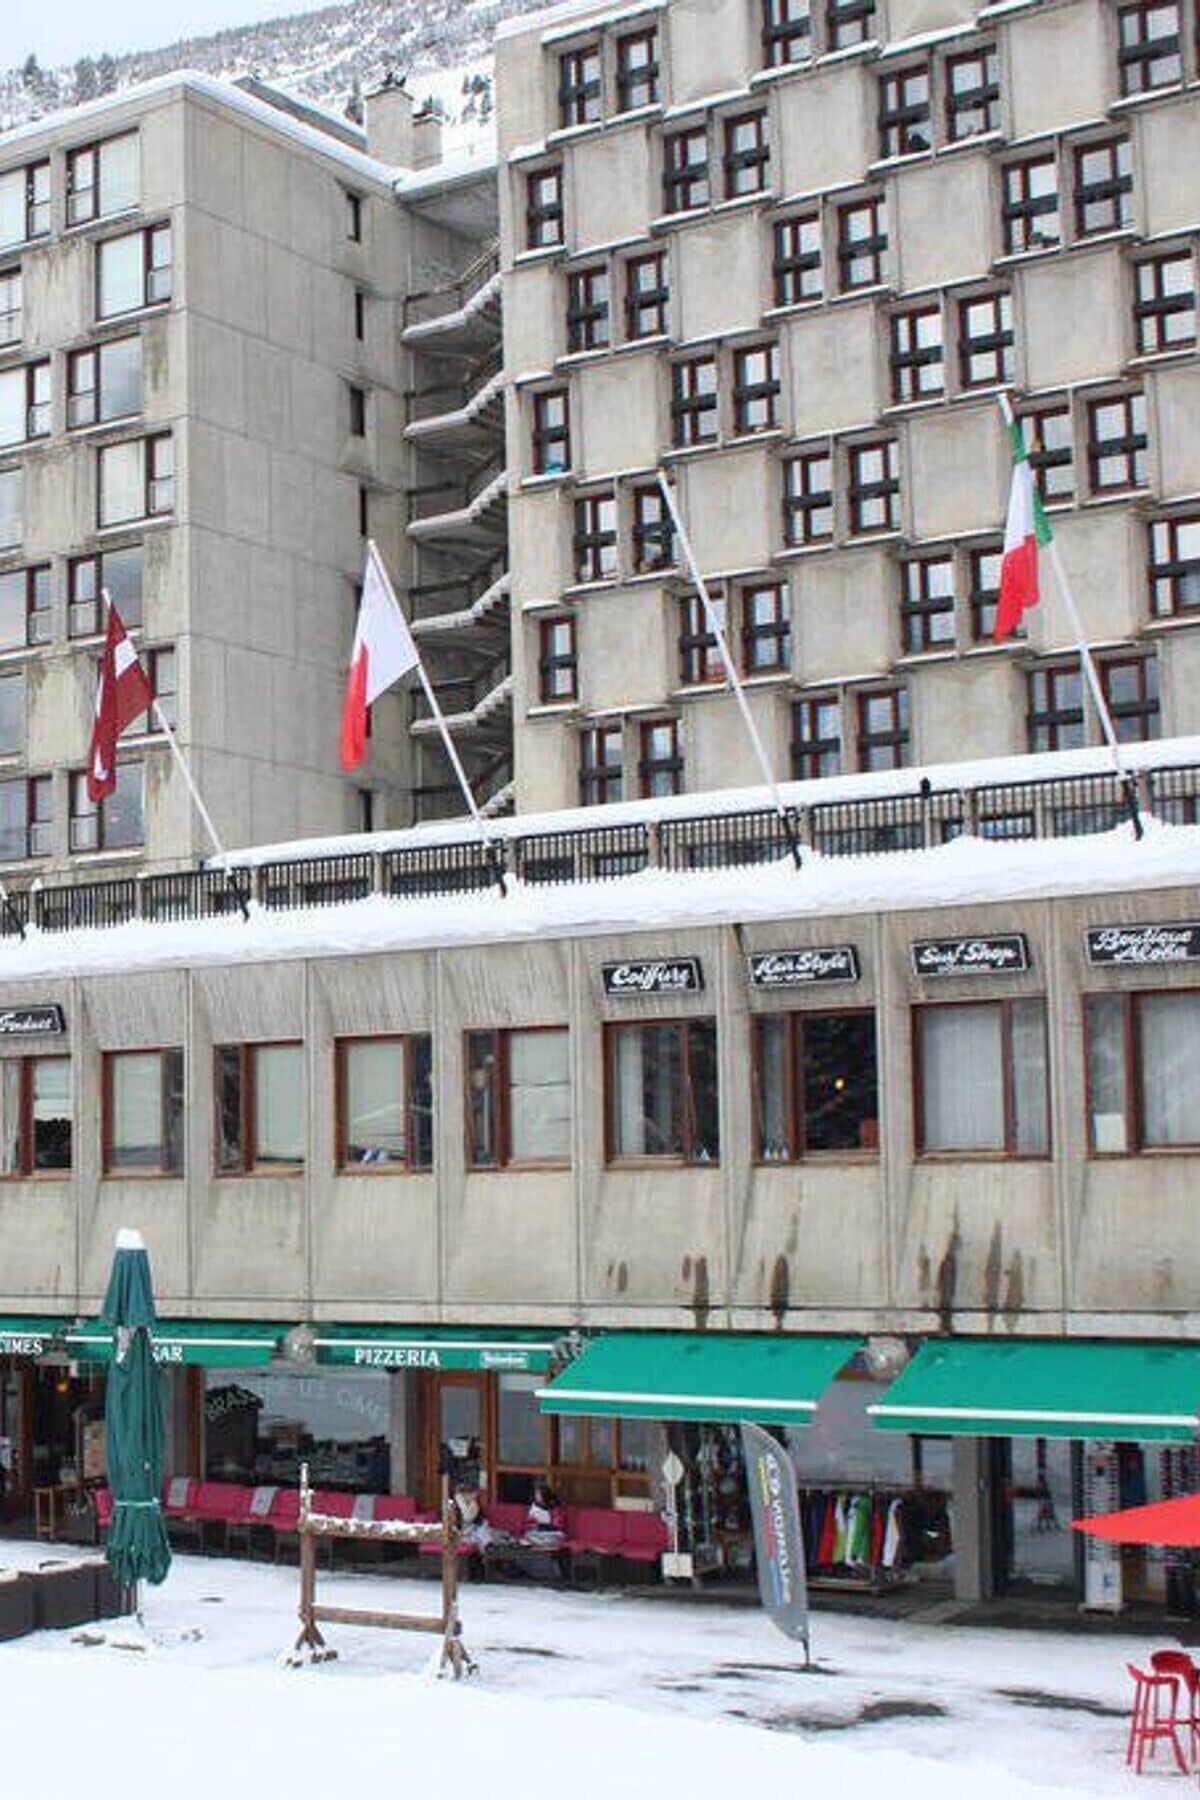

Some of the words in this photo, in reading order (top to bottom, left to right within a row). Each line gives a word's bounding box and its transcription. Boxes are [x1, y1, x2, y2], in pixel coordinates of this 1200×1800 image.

[1093, 929, 1192, 951] Boutique
[963, 941, 1017, 966] Shop
[611, 963, 689, 990] Coiffure
[355, 1349, 440, 1366] PIZZERIA
